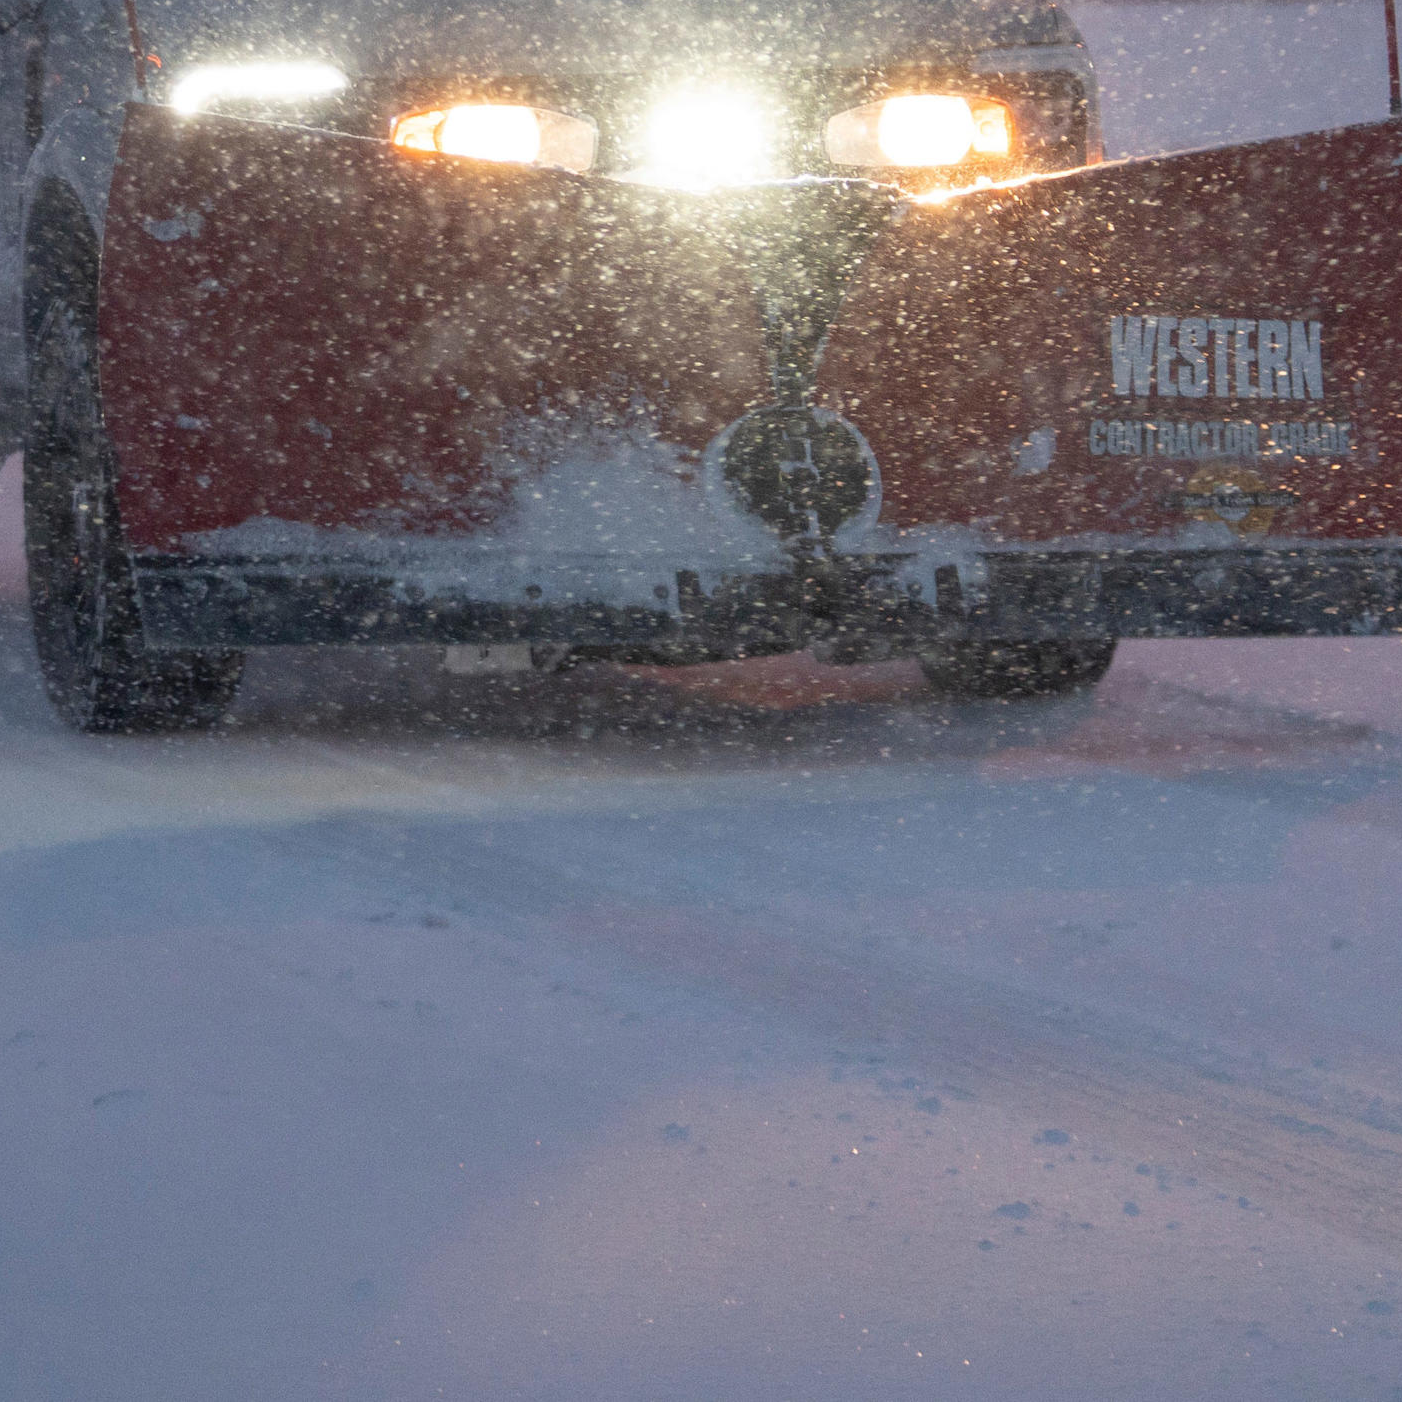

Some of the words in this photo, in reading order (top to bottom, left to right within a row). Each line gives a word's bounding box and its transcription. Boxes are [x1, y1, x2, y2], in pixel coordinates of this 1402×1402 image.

[1111, 316, 1324, 398] WESTERN
[1089, 419, 1259, 459] CONTRACTOR
[1270, 421, 1351, 456] GRADE
